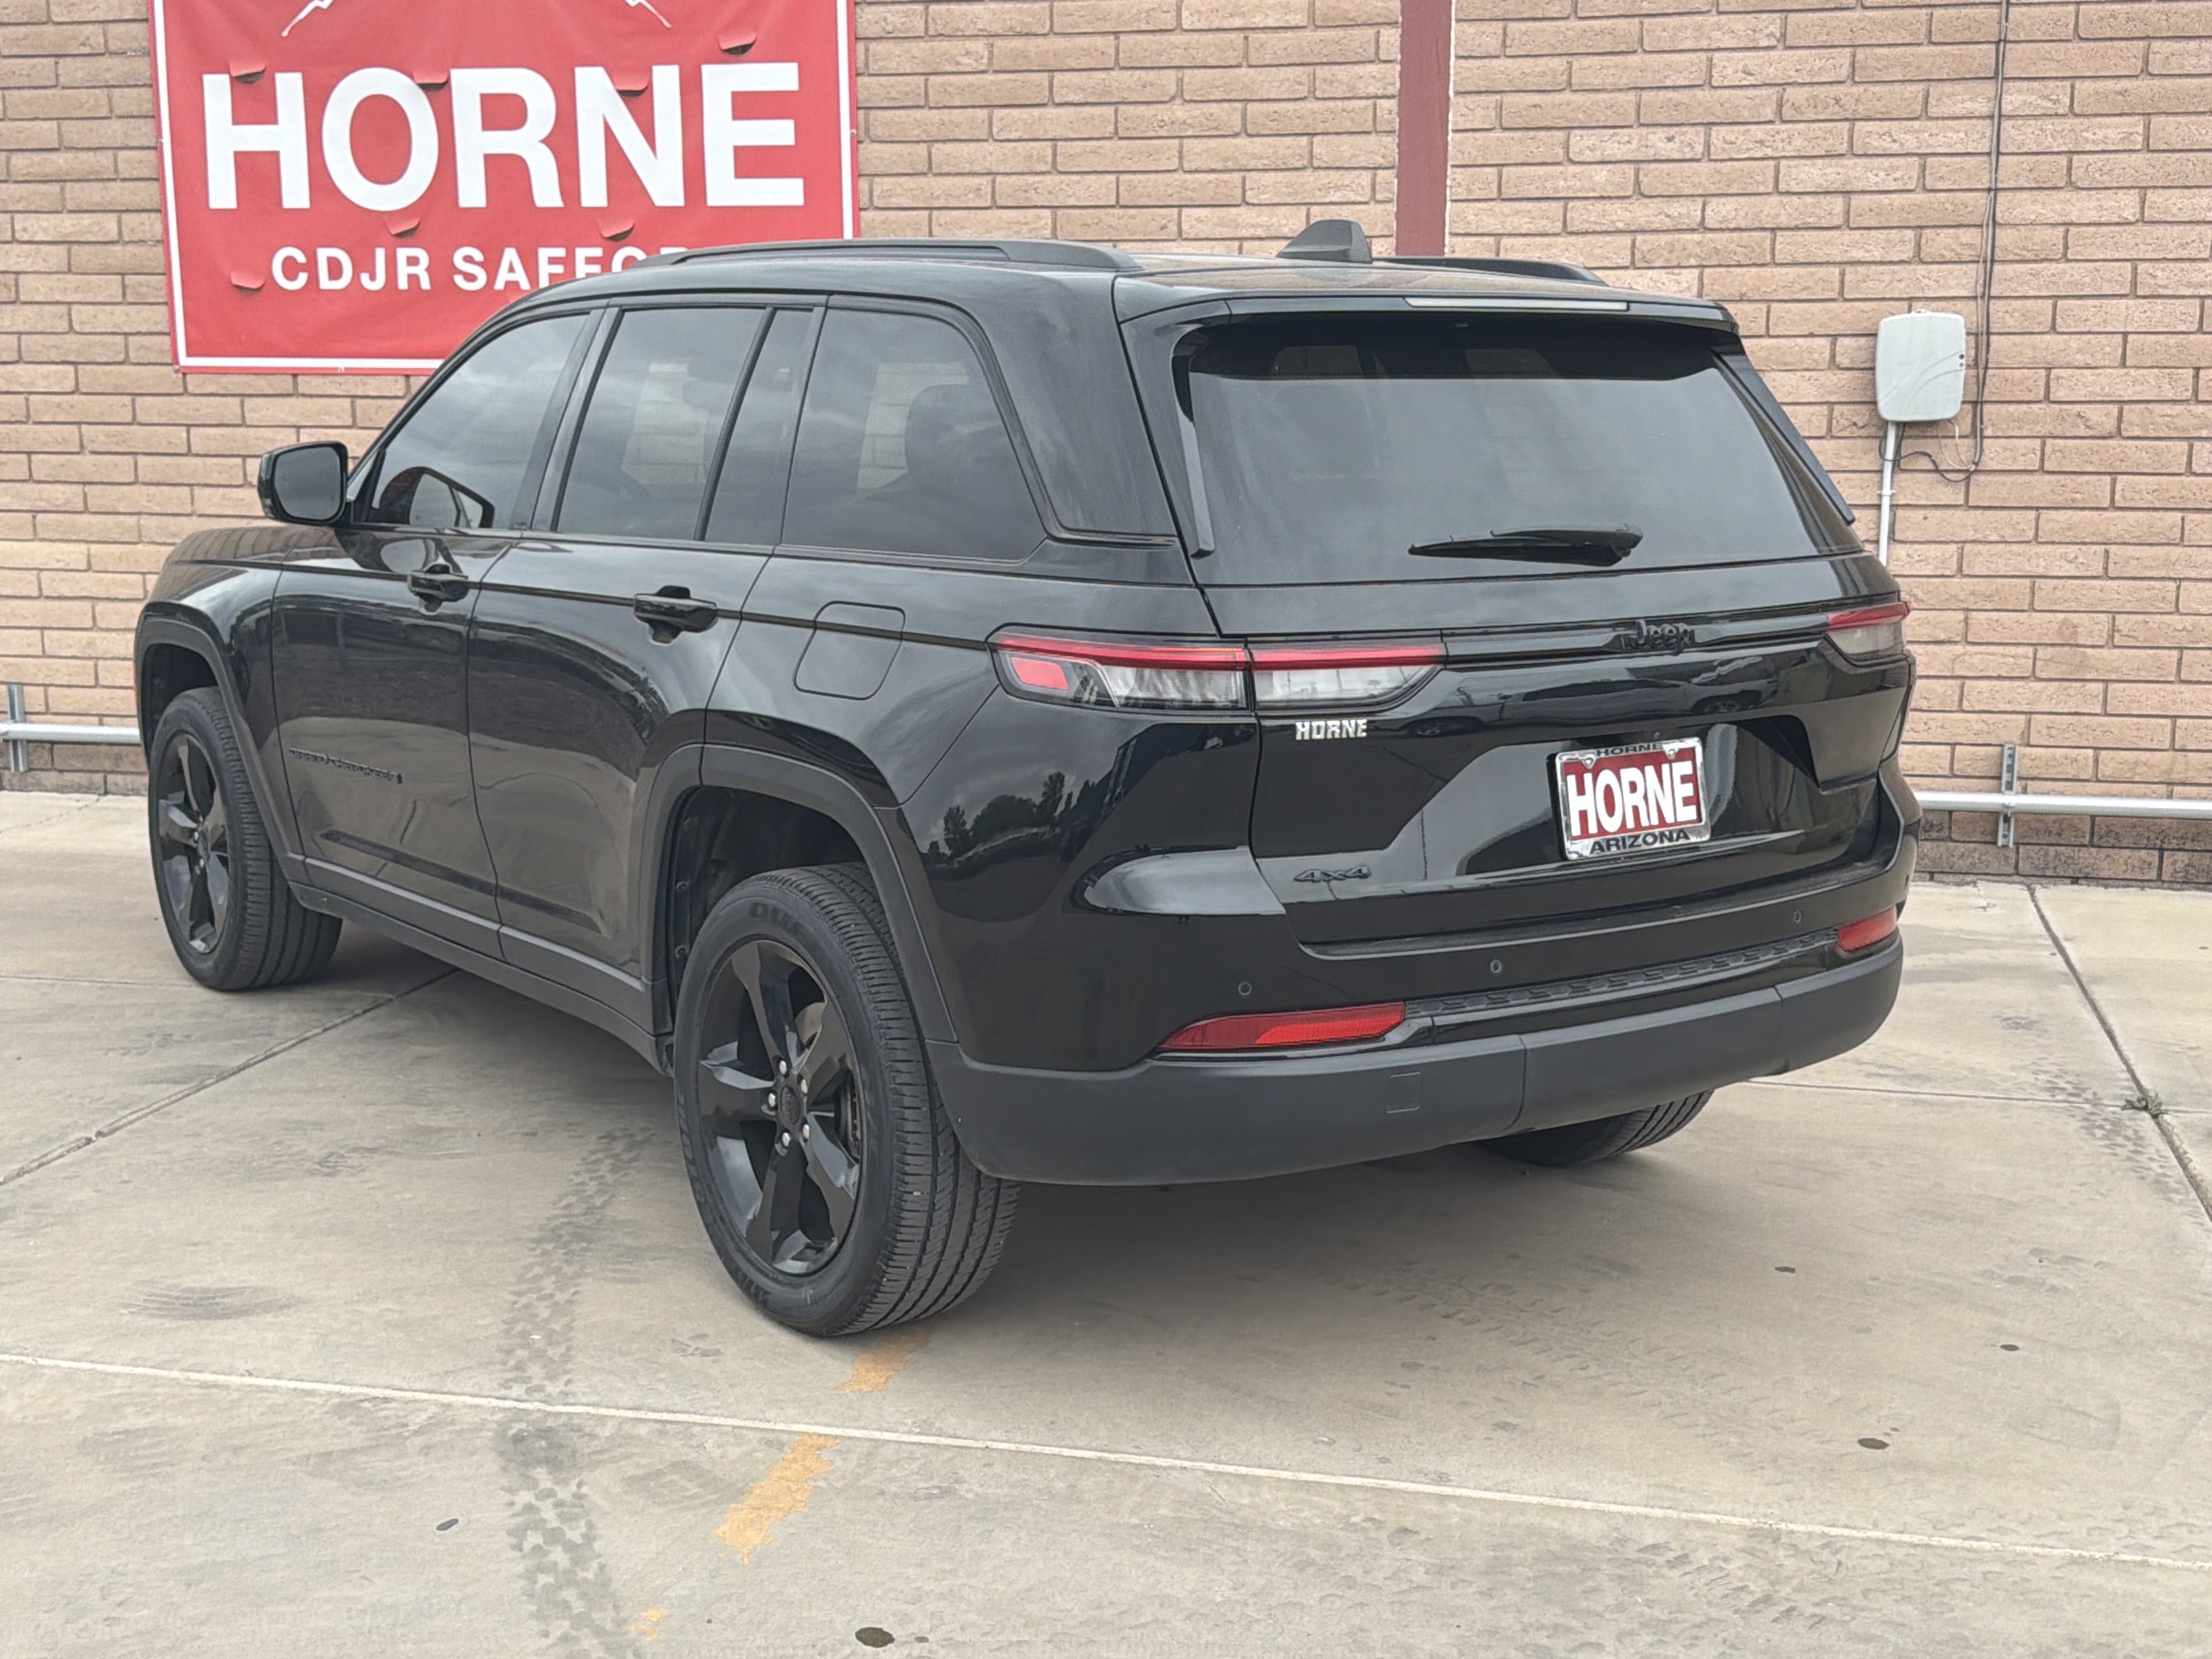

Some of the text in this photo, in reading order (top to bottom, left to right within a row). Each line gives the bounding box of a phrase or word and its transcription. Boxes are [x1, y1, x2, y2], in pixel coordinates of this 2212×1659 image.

[202, 61, 805, 212] HORNE
[272, 245, 689, 291] CDJR SAFF
[1629, 619, 1695, 654] Jeep
[1295, 719, 1367, 741] HORNE
[1596, 742, 1663, 757] HORNE
[1566, 760, 1697, 837] HORNE
[1589, 828, 1691, 855] ARIZONA
